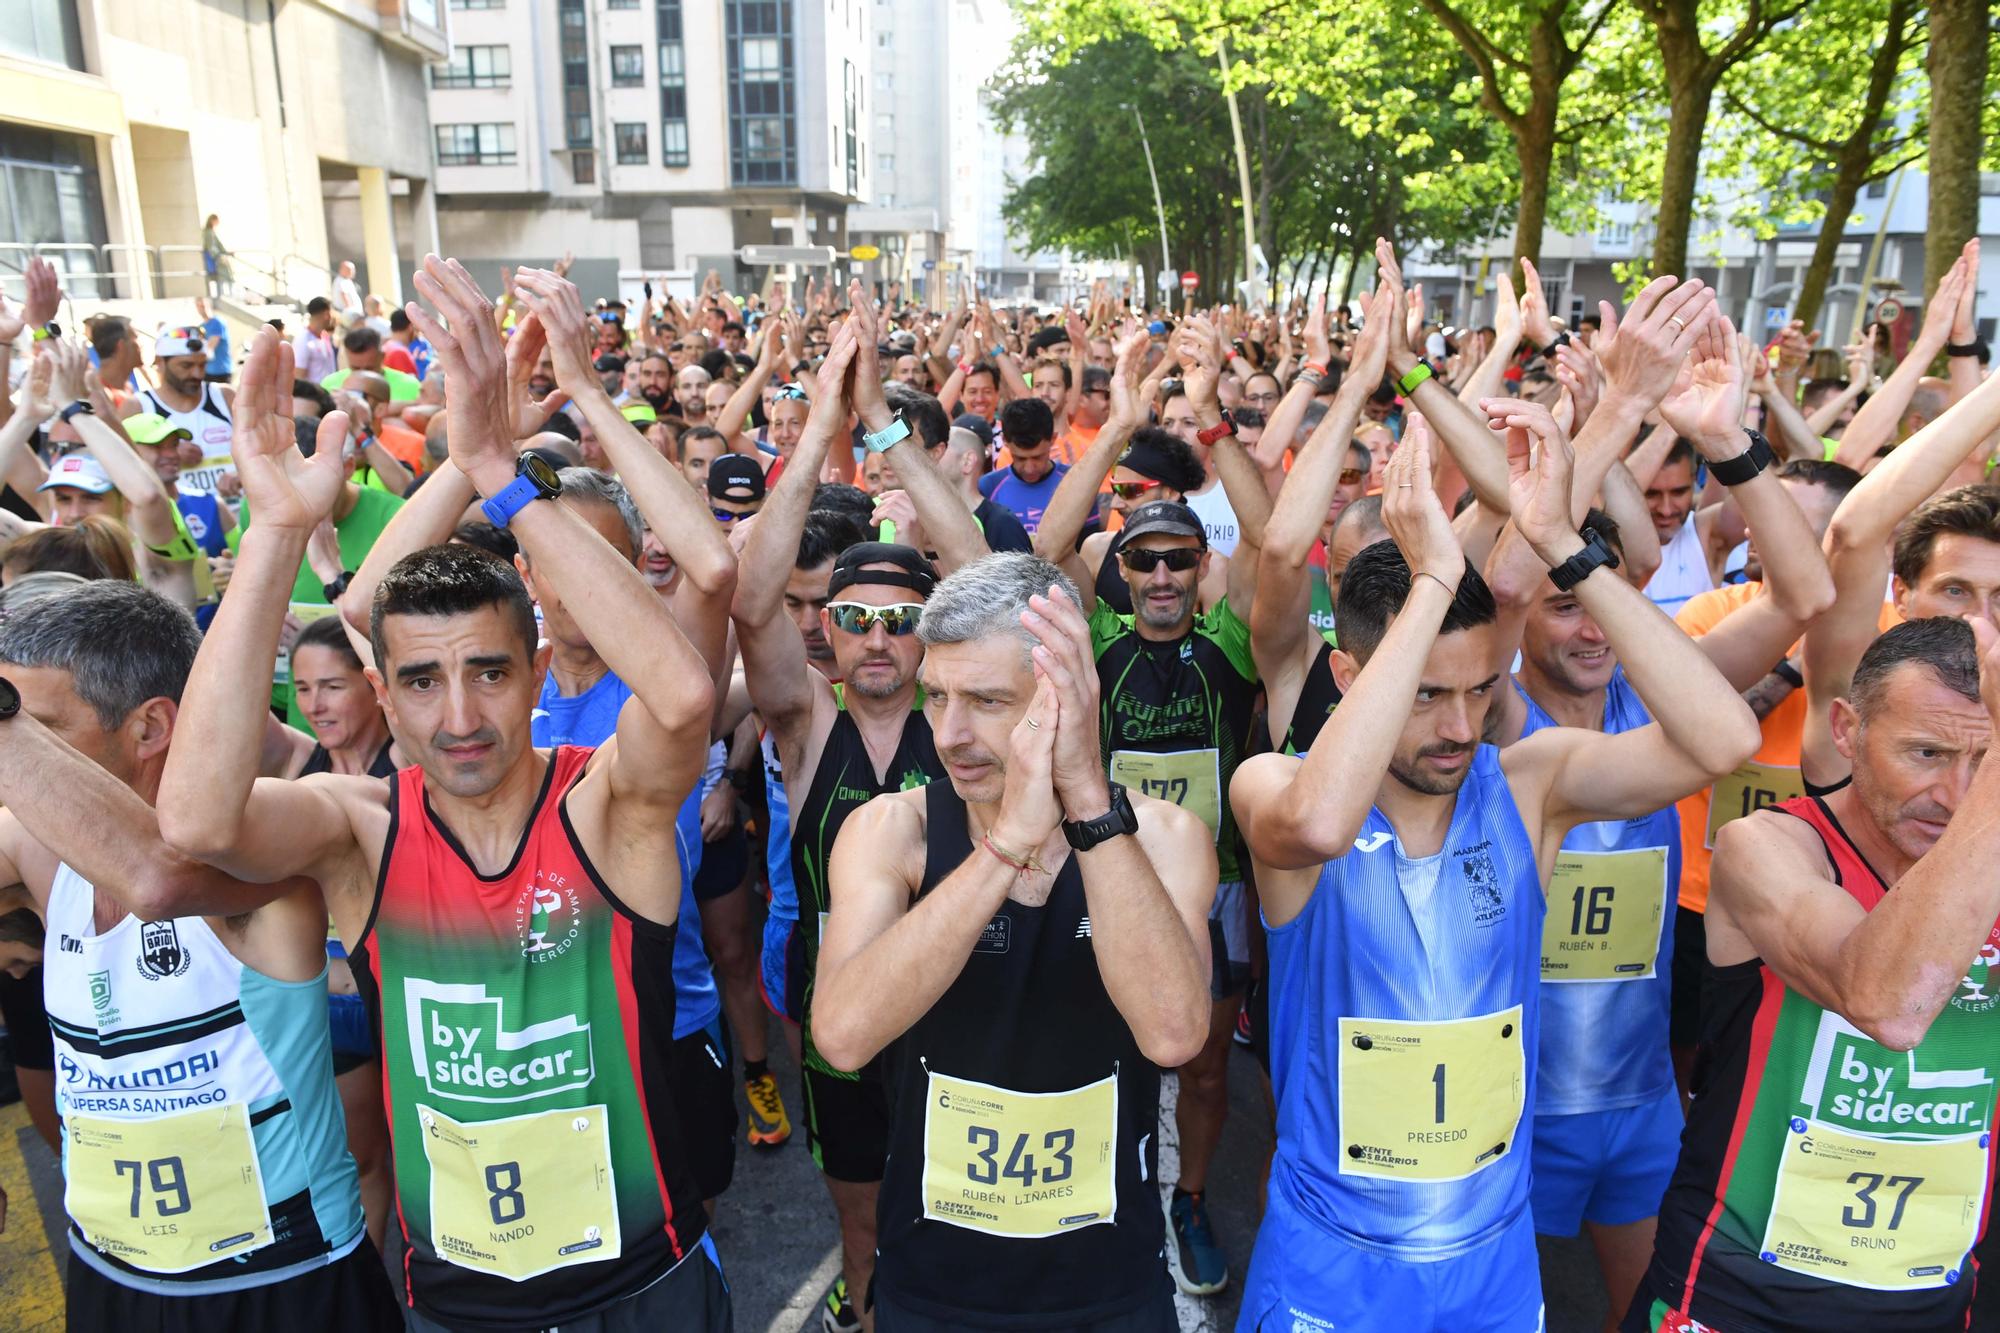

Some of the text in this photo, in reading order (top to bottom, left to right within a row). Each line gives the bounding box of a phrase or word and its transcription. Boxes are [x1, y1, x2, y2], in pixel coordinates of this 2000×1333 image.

[1571, 886, 1615, 935] 16
[1559, 940, 1595, 951] RUBÉN
[432, 1009, 482, 1059] by
[88, 1050, 219, 1090] HYUNDAI
[1839, 1045, 1894, 1099] by
[133, 1088, 227, 1113] SANTIAGO
[1432, 1064, 1445, 1124] 1
[1408, 1129, 1468, 1144] PRESEDO
[967, 1125, 1075, 1187] 343
[1374, 1154, 1418, 1166] BARRIOS
[114, 1156, 191, 1219] 79
[485, 1161, 526, 1225] 8
[962, 1185, 1074, 1206] RUBÉN LIÑARES
[1841, 1171, 1925, 1231] 37
[957, 1208, 999, 1221] BARRIOS
[143, 1223, 178, 1237] LEIS
[490, 1224, 535, 1244] NANDO
[460, 1246, 497, 1261] BARRIOS
[1787, 1243, 1823, 1255] XENTE
[1850, 1236, 1896, 1251] BRUNO
[1776, 1247, 1798, 1257] DOS
[1800, 1252, 1848, 1267] BARRIOS
[1288, 1306, 1335, 1330] MARINEDA
